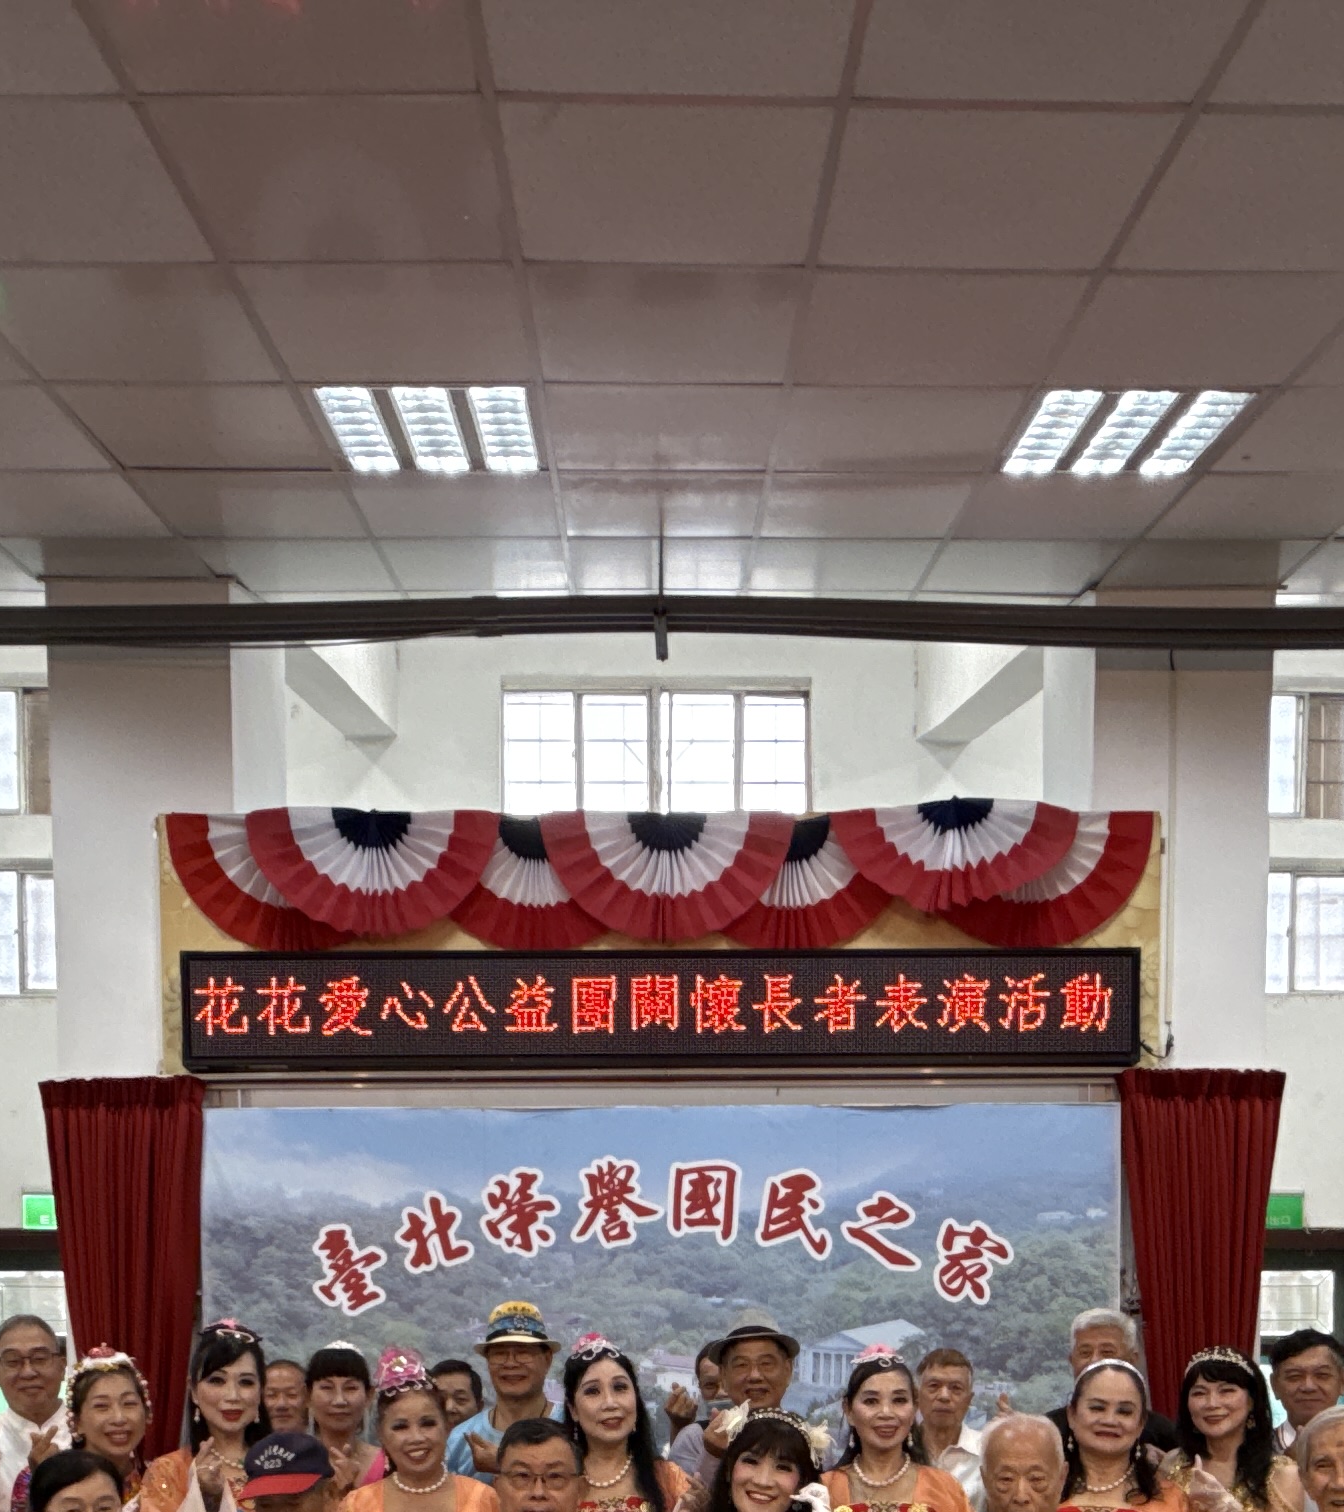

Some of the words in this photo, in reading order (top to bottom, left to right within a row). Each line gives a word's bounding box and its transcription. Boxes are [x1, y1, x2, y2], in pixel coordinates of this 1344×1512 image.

[194, 972, 1113, 1037] 花花愛心公益團關懷長者表演活動
[316, 1160, 1010, 1313] 臺北榮譽國民之家
